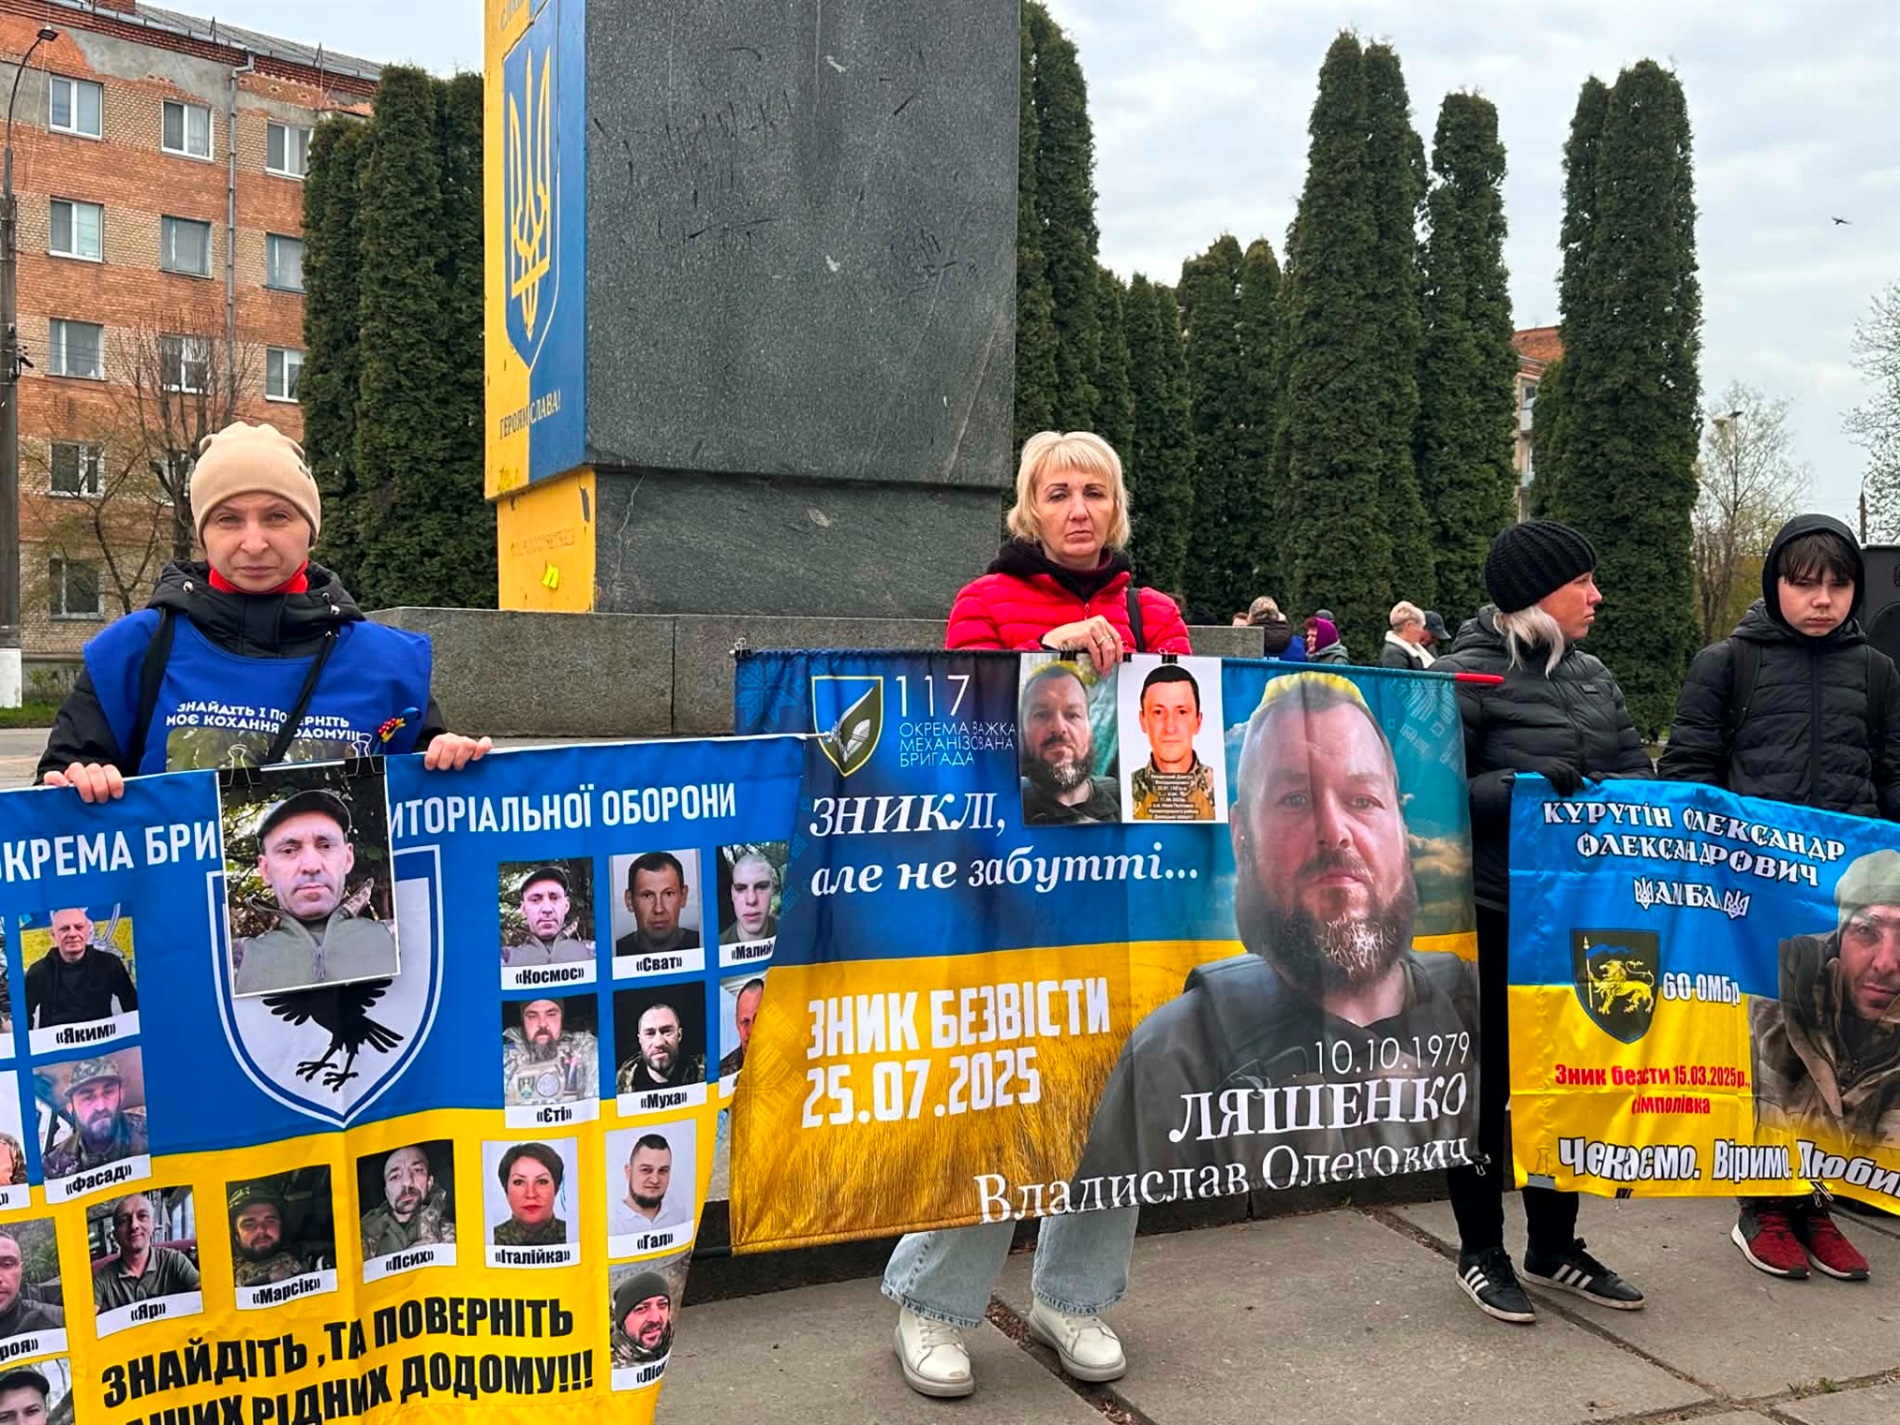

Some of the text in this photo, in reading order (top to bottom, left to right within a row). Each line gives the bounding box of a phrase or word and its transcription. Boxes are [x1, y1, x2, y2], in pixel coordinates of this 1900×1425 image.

[530, 388, 561, 424] СЛАВА!
[895, 675, 970, 717] 117
[166, 714, 199, 727] МОЄ
[204, 715, 280, 733] КОХАННЯ
[899, 721, 1017, 737] ОКРЕМА ВАЖКА
[899, 735, 1015, 751] МЕХАНІЗОВАНА
[900, 751, 975, 767] БРИГАДА
[389, 783, 735, 838] ИТОРІАЛЬНОЇ ОБОРОНИ
[809, 792, 1006, 838] ЗНИКЛІ,
[1683, 807, 1845, 862] ОЛЕКСАНДР
[0, 832, 134, 883] КРЕМА
[1577, 832, 1819, 886] ОЛЕКСАНДРОВИЧ
[811, 866, 883, 896] але
[898, 860, 957, 891] не
[515, 967, 584, 986] «Космос»
[636, 956, 683, 973] «Сват»
[1662, 972, 1740, 1008] 60 ОМБр
[56, 1023, 117, 1045] «Яким»
[806, 977, 1111, 1060] ЗНИК БЕЗВІСТИ
[1315, 1031, 1470, 1075] 10.10.1979
[802, 1046, 1041, 1129] 25.07.2025
[1555, 1064, 1607, 1086] Зник
[537, 1106, 572, 1122] «Єті»
[640, 1091, 688, 1110] «Муха»
[1168, 1072, 1468, 1143] ЛЯШЕНКО
[66, 1164, 132, 1195] «Фасад»
[973, 1137, 1475, 1226] Владислав Олегович
[1558, 1136, 1900, 1199] Чекаємо. Віримо. Люби
[495, 1247, 571, 1265] «Італійка»
[637, 1232, 674, 1250] «Гал»
[386, 1249, 434, 1272] «Псих»
[252, 1277, 320, 1305] «Марсік»
[131, 1302, 166, 1322] «Яр»
[0, 1338, 39, 1361] роя»
[102, 1334, 308, 1408] ЗНАЙДІТЬ
[374, 1297, 573, 1348] ПОВЕРНІТЬ
[401, 1349, 593, 1402] ДОДОМУ!!!
